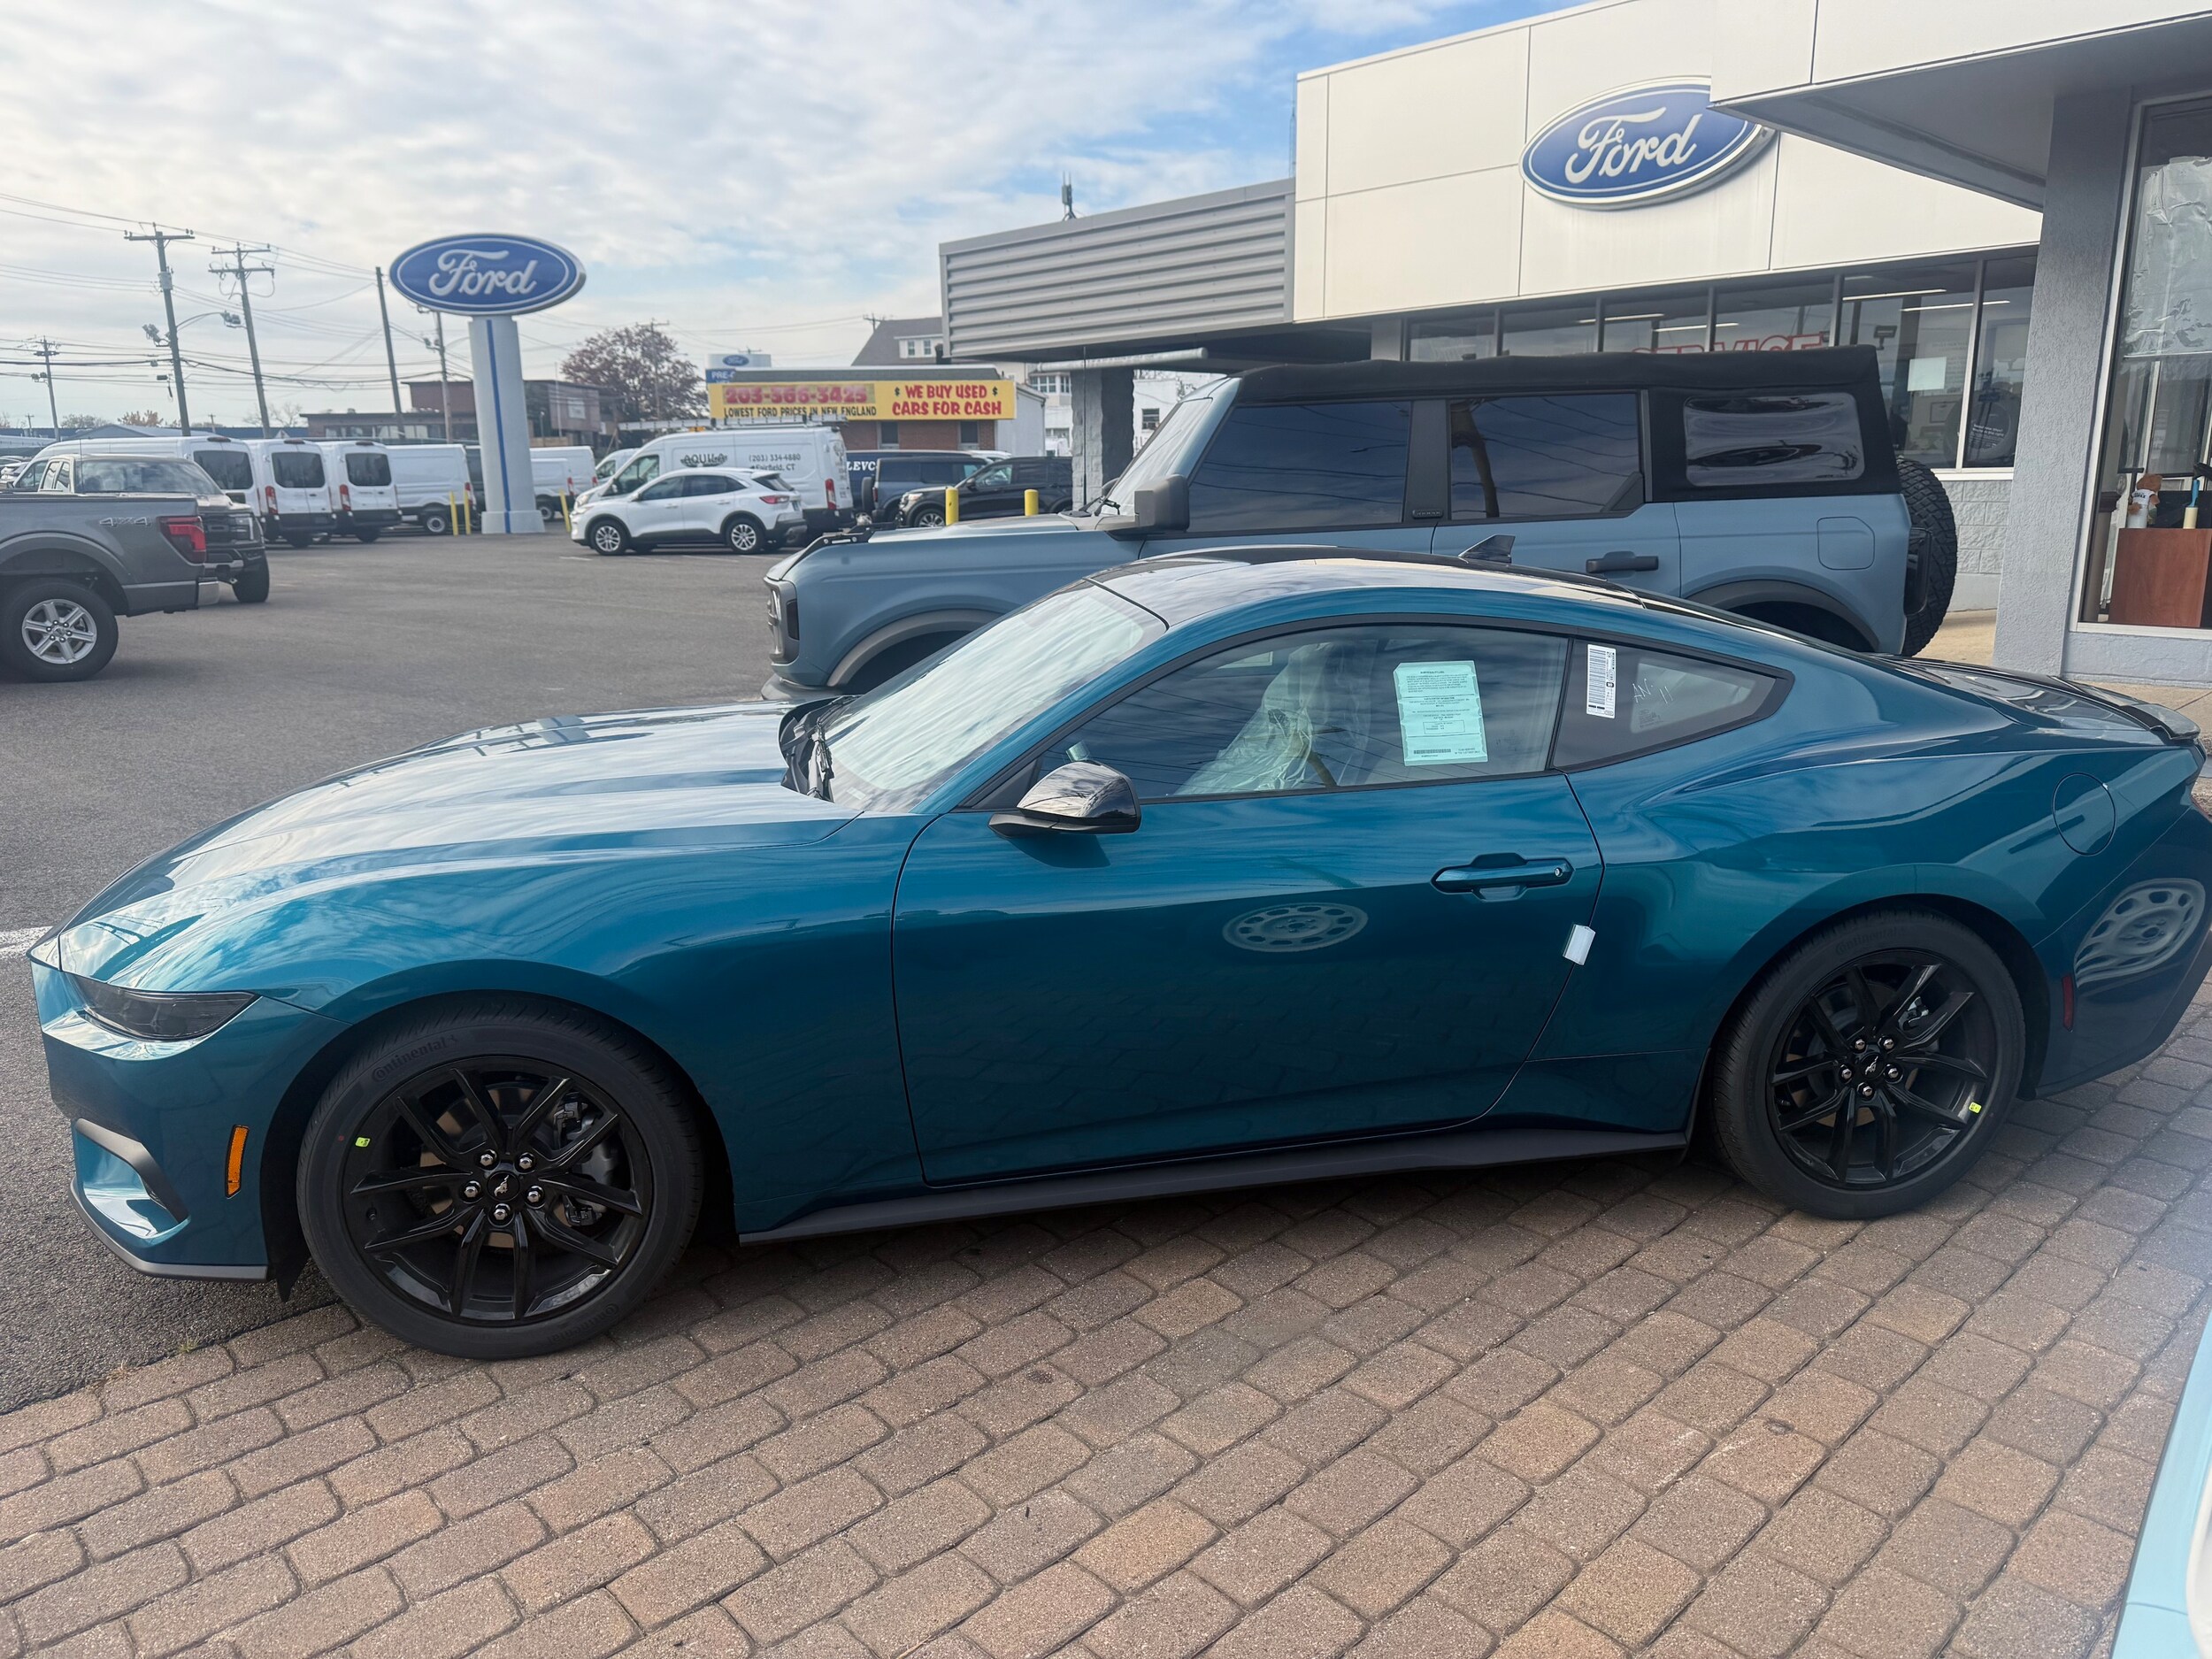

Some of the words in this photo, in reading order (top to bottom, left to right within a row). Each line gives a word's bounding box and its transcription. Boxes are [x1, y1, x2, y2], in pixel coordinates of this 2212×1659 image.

[1565, 107, 1702, 184] Ford
[428, 249, 539, 296] Ford
[905, 385, 923, 398] WE
[926, 385, 952, 398] BUY
[956, 385, 987, 398] USED
[724, 408, 754, 418] LOWEST
[757, 407, 777, 418] FORD
[780, 407, 807, 417] PRICES
[810, 406, 818, 416] IN
[821, 406, 838, 416] NEW
[841, 406, 877, 416] ENGLAND
[892, 401, 929, 416] CARS
[933, 401, 960, 415] FOR
[964, 401, 1002, 415] CASH
[373, 1036, 448, 1082] Continental
